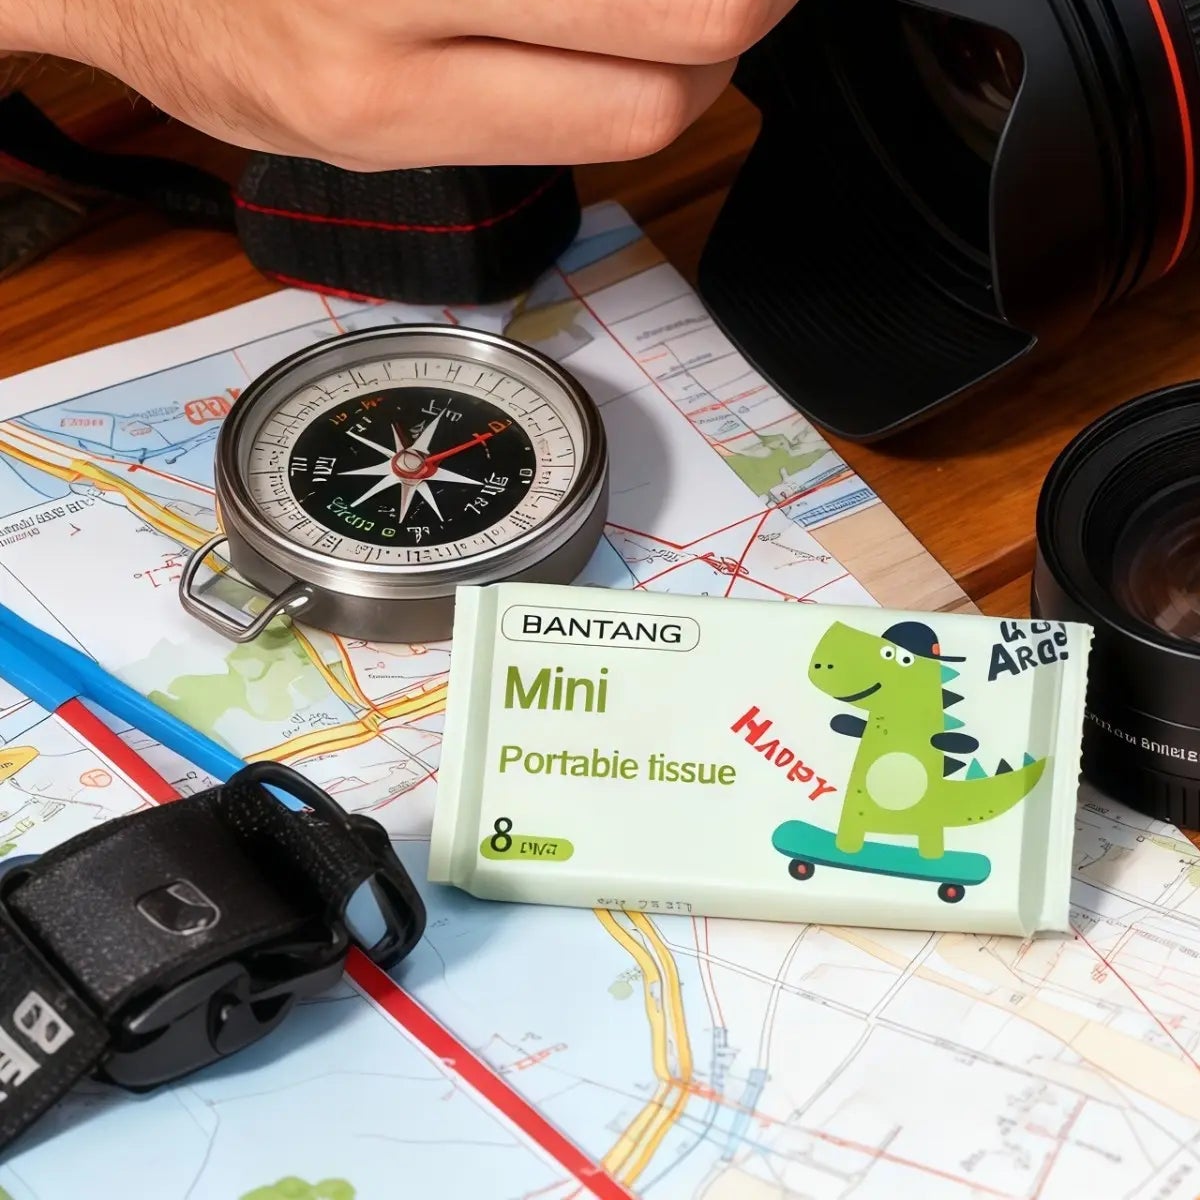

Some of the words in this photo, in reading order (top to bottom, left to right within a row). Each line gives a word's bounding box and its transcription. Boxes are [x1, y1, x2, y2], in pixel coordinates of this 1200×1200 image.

[522, 614, 682, 644] BANTANG
[503, 665, 609, 714] Mini
[647, 752, 737, 786] tissue
[490, 816, 513, 853] 8
